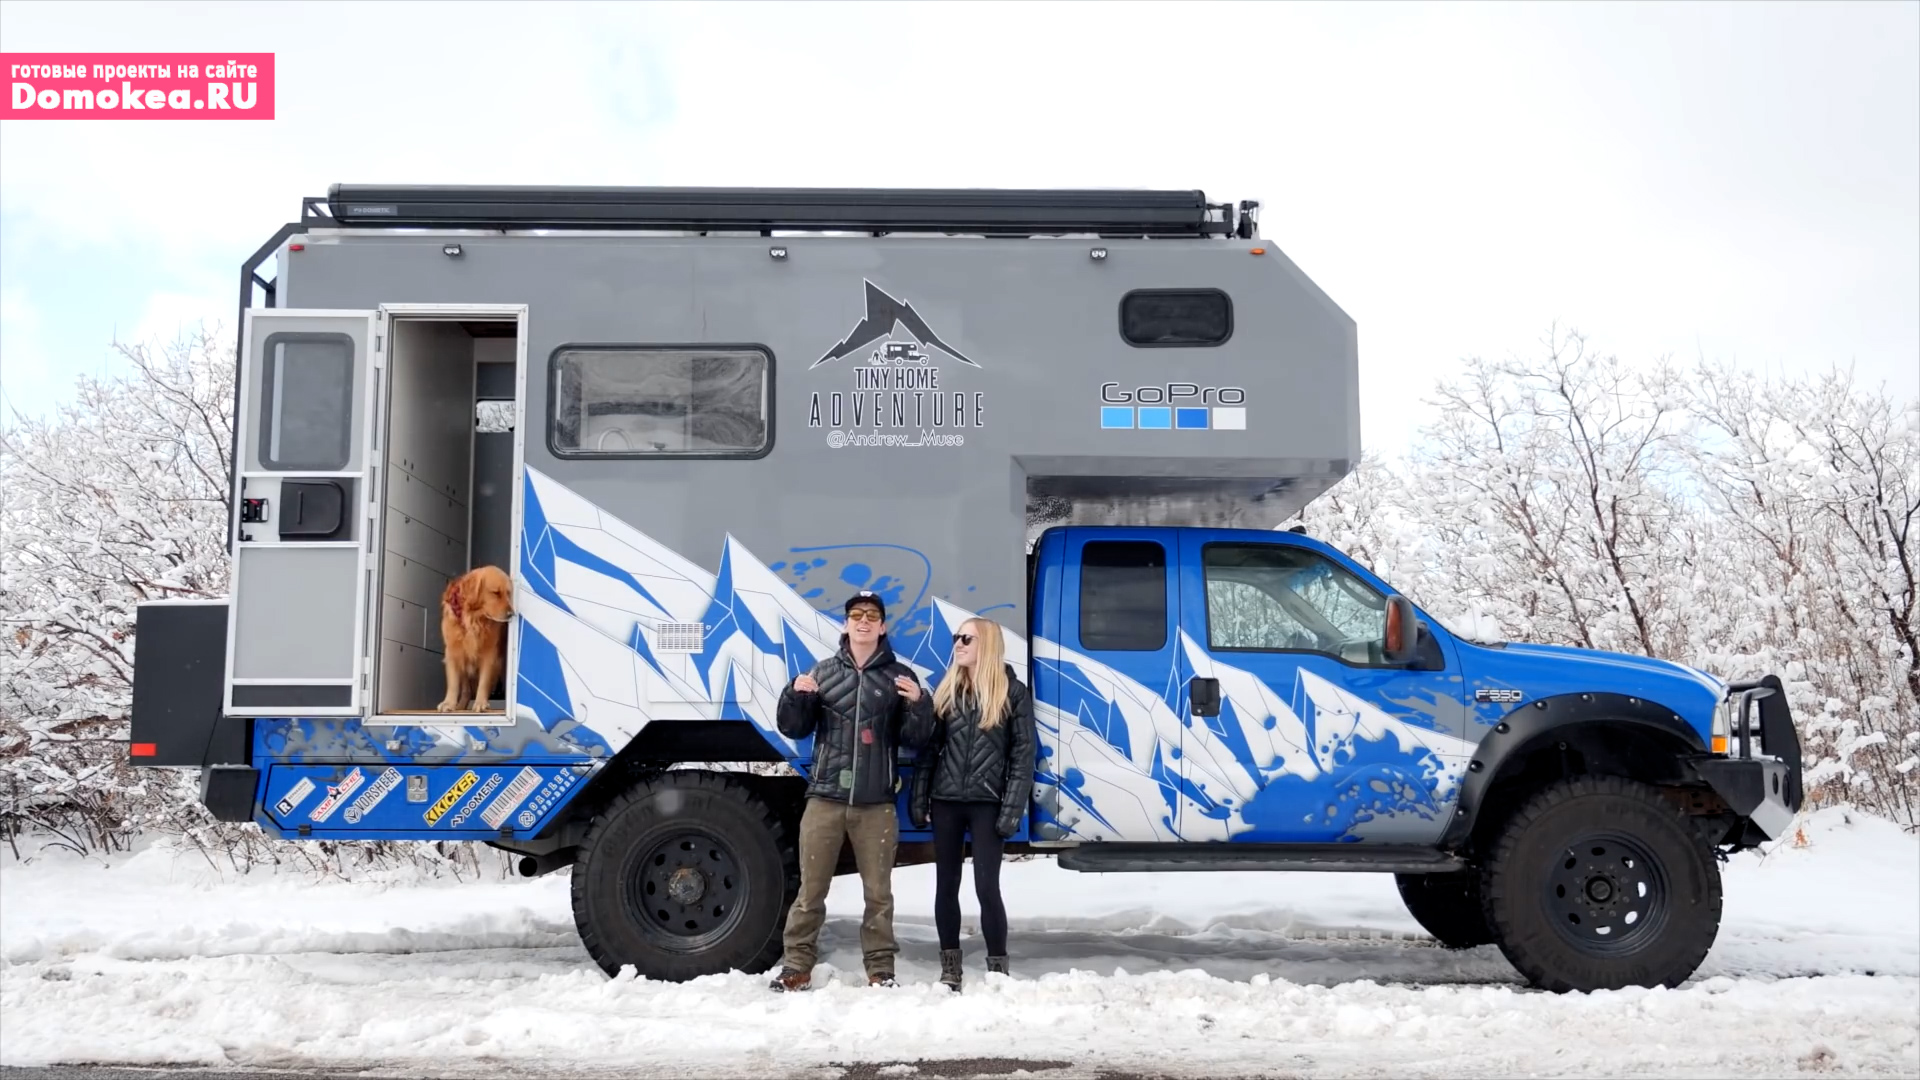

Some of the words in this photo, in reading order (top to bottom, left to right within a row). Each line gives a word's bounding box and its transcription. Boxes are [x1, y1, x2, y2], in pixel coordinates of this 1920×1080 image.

[854, 367, 891, 390] TINY
[895, 367, 939, 390] HOME
[1100, 381, 1246, 406] GoPro
[808, 391, 984, 427] ADVENTURE
[312, 799, 333, 821] CAMP
[341, 770, 361, 793] CHEF
[355, 767, 400, 811] VORSHEER
[462, 773, 503, 817] DOMETIC
[529, 767, 570, 811] OAKLEY
